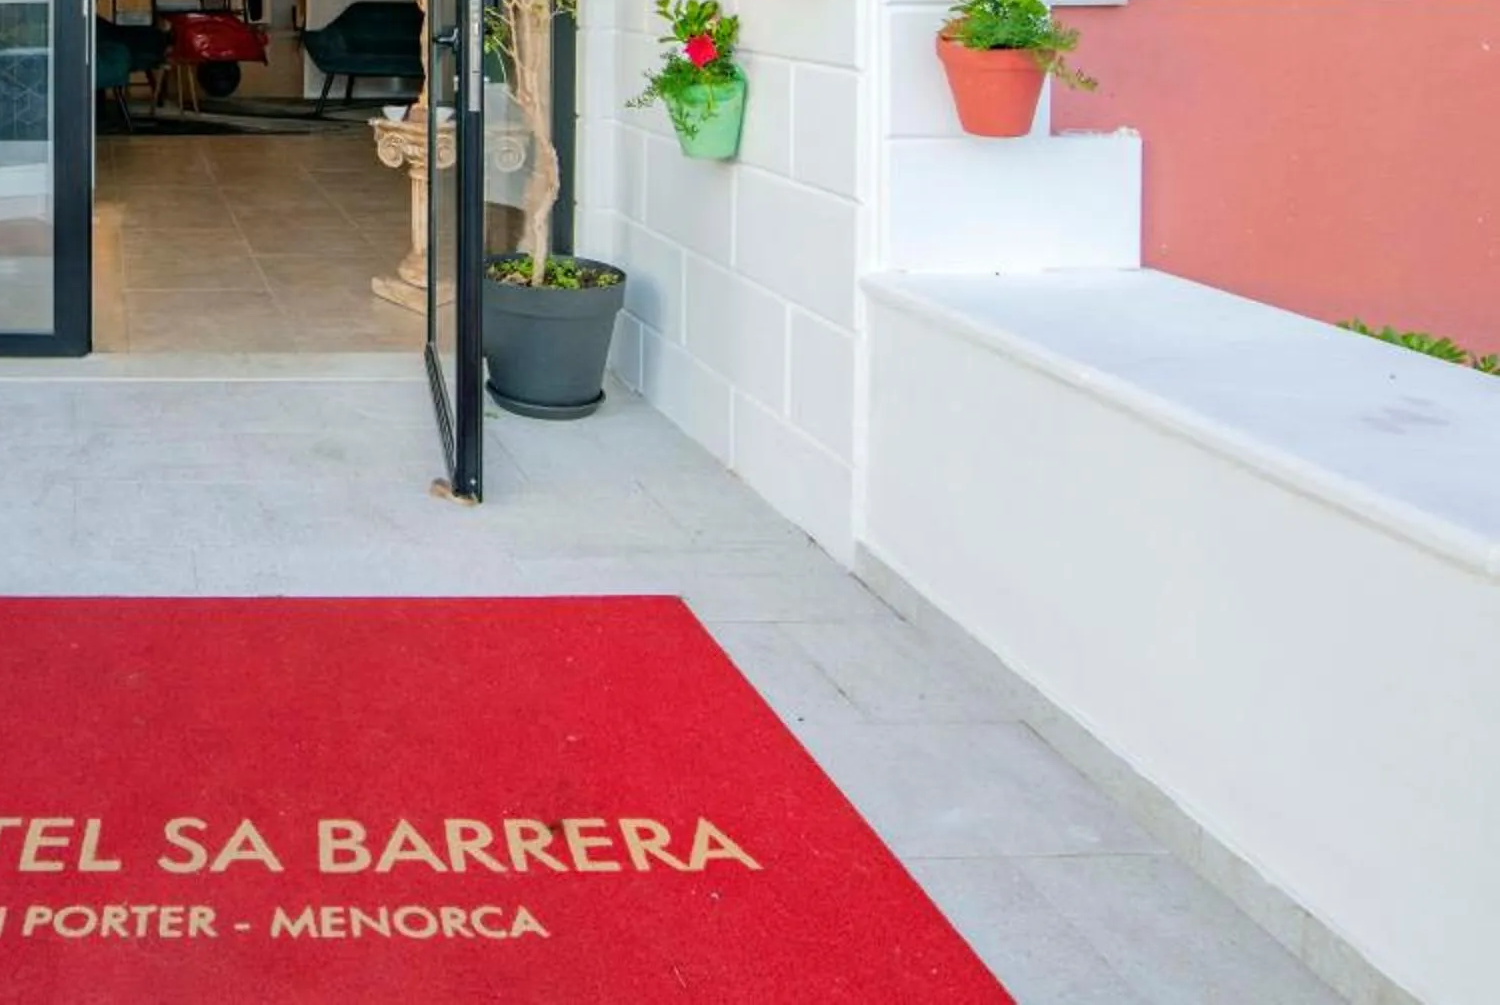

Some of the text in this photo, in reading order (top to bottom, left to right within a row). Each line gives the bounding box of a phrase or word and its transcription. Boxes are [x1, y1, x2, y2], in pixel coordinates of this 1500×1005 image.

[157, 817, 285, 874] SA
[317, 817, 763, 873] BARRERA
[22, 904, 218, 938] PORTER
[270, 905, 550, 939] MENORCA
